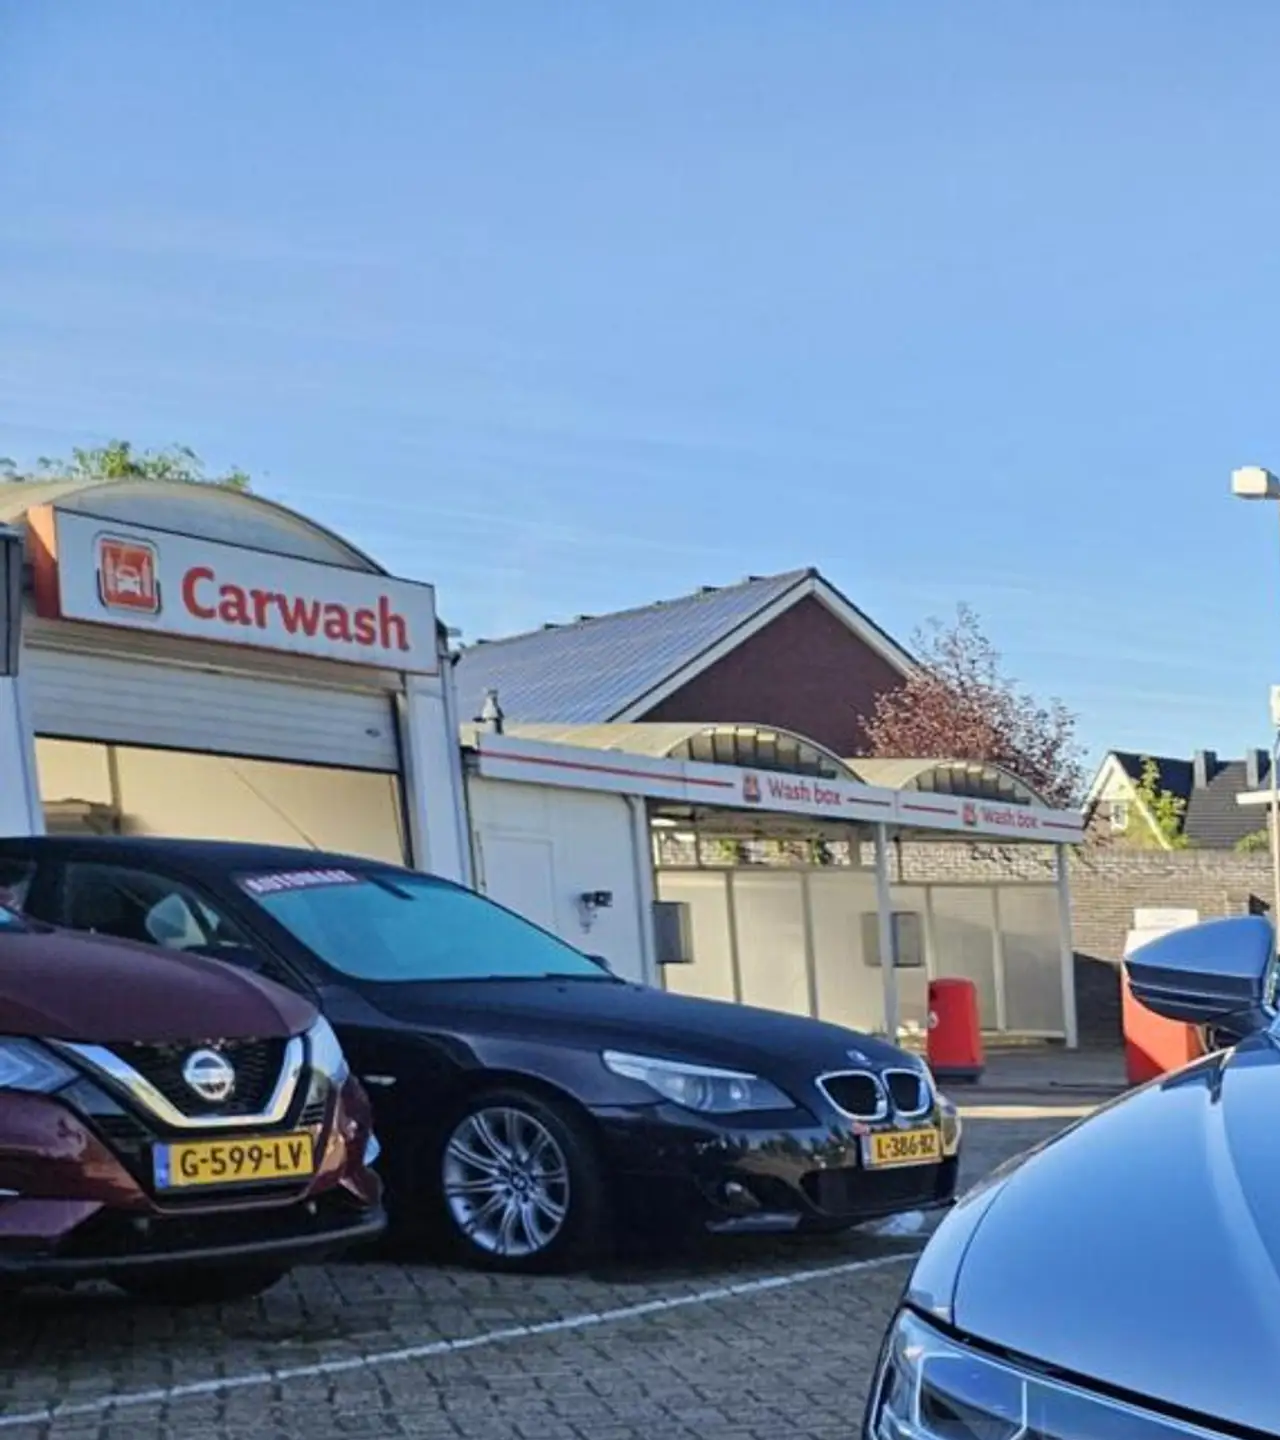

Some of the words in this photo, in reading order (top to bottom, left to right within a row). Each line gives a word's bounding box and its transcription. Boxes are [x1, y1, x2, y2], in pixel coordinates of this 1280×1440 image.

[181, 565, 411, 651] Carwash
[766, 776, 811, 802] Wash
[813, 781, 842, 806] box
[180, 1140, 303, 1178] G-599-LV
